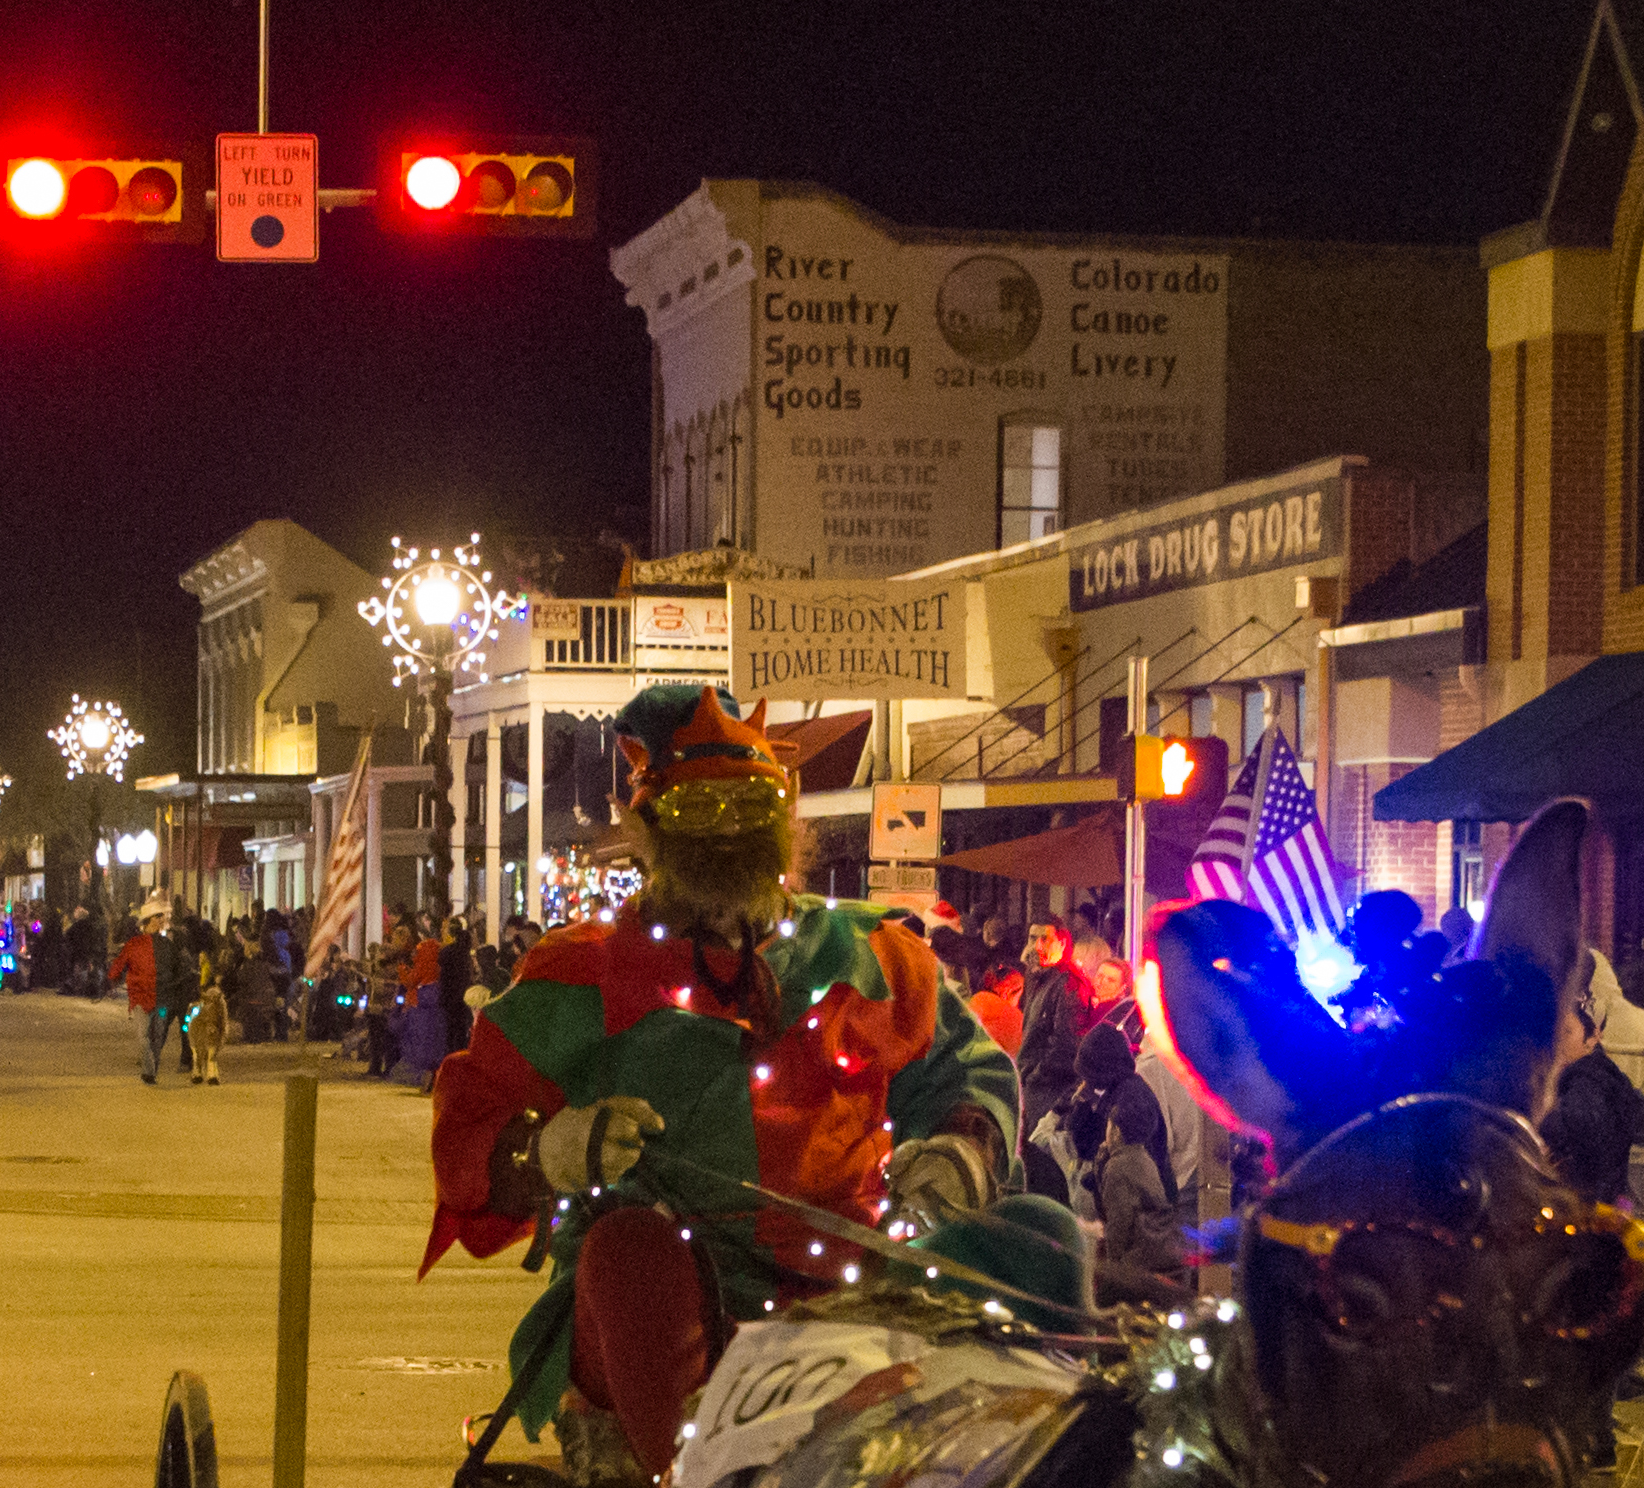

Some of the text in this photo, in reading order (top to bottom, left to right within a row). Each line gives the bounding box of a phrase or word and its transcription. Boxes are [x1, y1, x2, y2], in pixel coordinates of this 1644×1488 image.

[224, 146, 310, 161] LEFT TURN
[242, 167, 293, 186] YIELD
[228, 193, 302, 207] ON GREEN
[764, 245, 853, 281] River
[1071, 258, 1219, 294] Colorado
[764, 292, 899, 336] Country
[1071, 302, 1168, 335] Canoe
[764, 334, 911, 380] Sporting
[1071, 343, 1176, 388] Livery
[764, 376, 862, 420] Goods
[816, 464, 938, 485] ATHLETIC
[821, 491, 933, 512] CAMPING
[822, 518, 930, 538] HUNTING
[1083, 492, 1322, 597] LOCK DRUG STORE
[748, 590, 949, 633] BLUEBONNET
[750, 649, 831, 690] HOME
[839, 648, 950, 688] HEALTH
